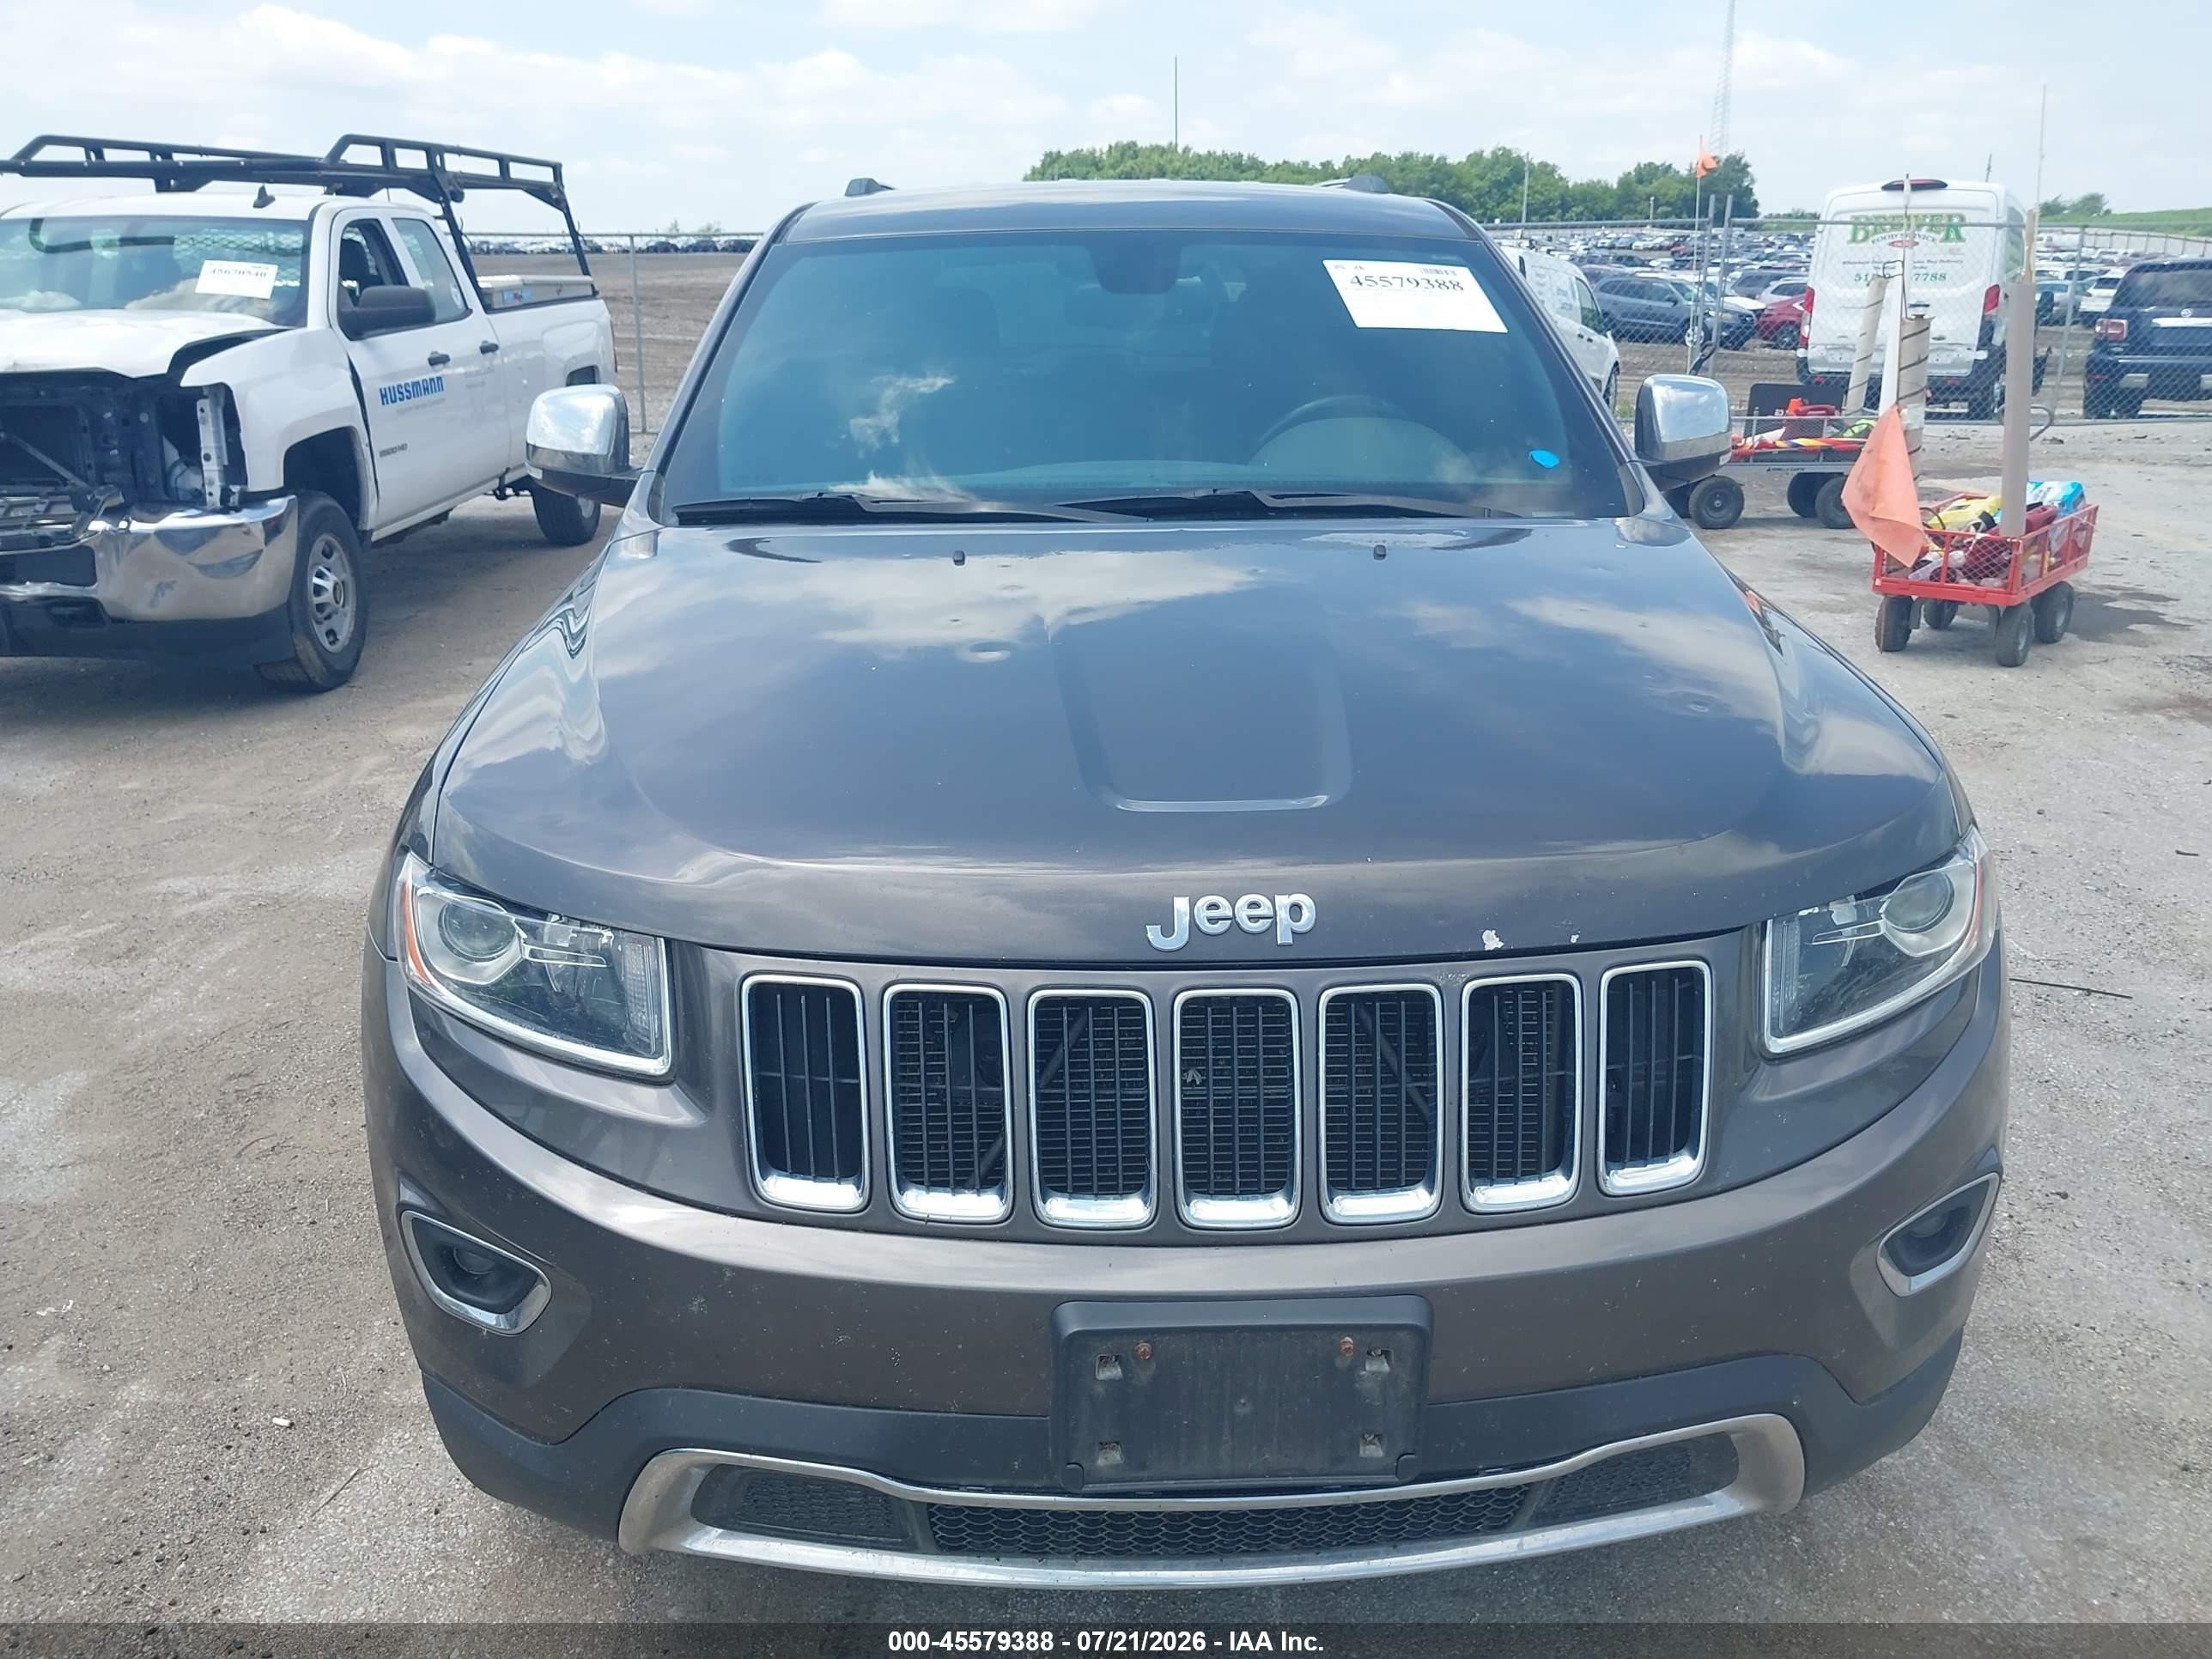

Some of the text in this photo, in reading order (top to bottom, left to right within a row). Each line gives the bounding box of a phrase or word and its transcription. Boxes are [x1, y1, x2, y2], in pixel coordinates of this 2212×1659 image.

[1870, 234, 1898, 246] FOOD
[1899, 233, 1938, 244] SEVICE
[1350, 274, 1465, 292] 45579388
[379, 375, 444, 406] HUSSMANN
[1146, 893, 1316, 951] Jeep
